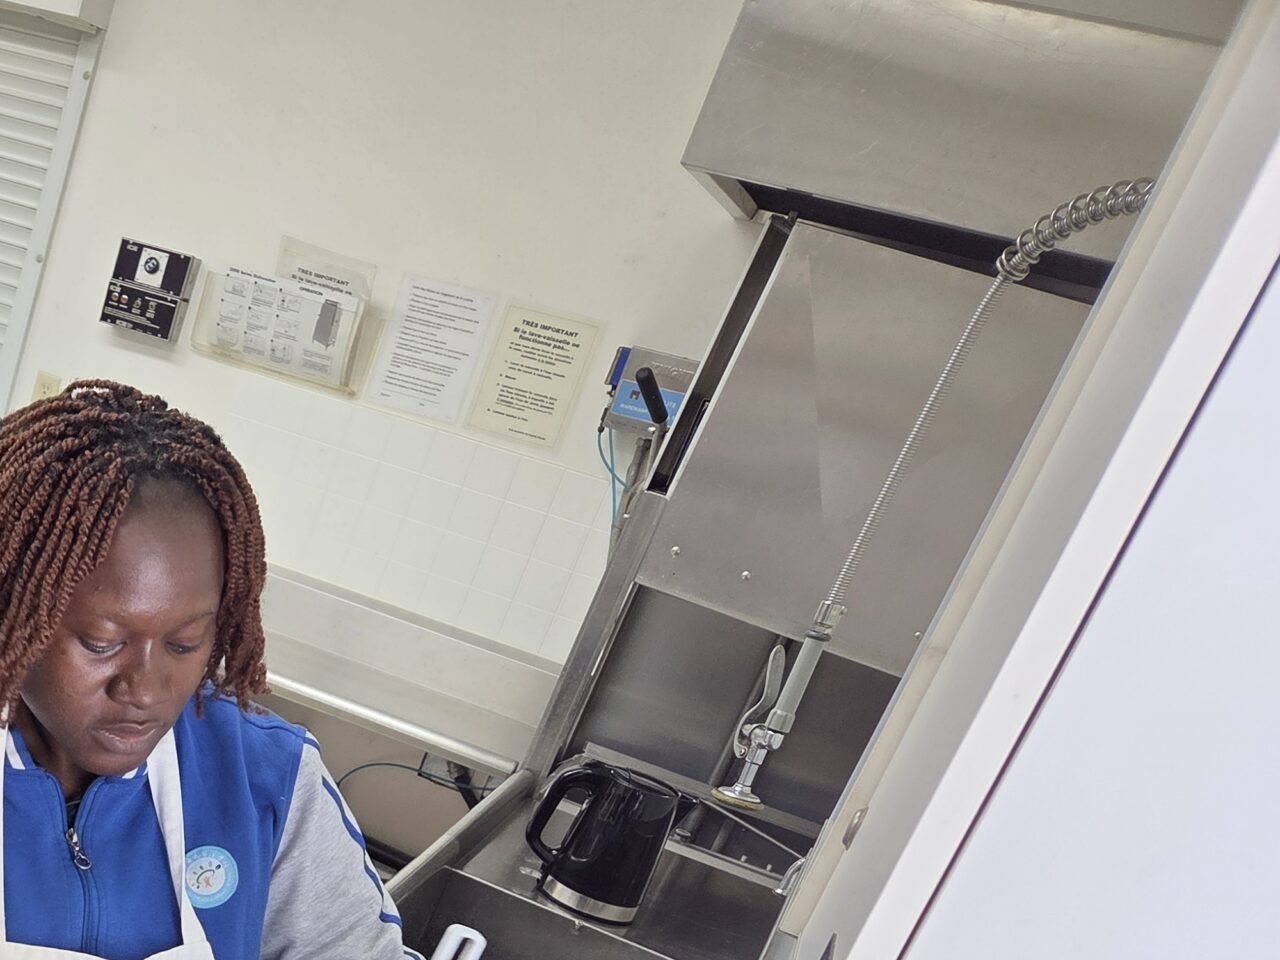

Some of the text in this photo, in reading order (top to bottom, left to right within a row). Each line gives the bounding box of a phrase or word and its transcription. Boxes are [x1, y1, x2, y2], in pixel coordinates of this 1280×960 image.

[314, 272, 349, 286] IMPORTANT
[522, 319, 579, 338] TRÈS IMPORTANT
[528, 330, 570, 345] lave-vaisselle
